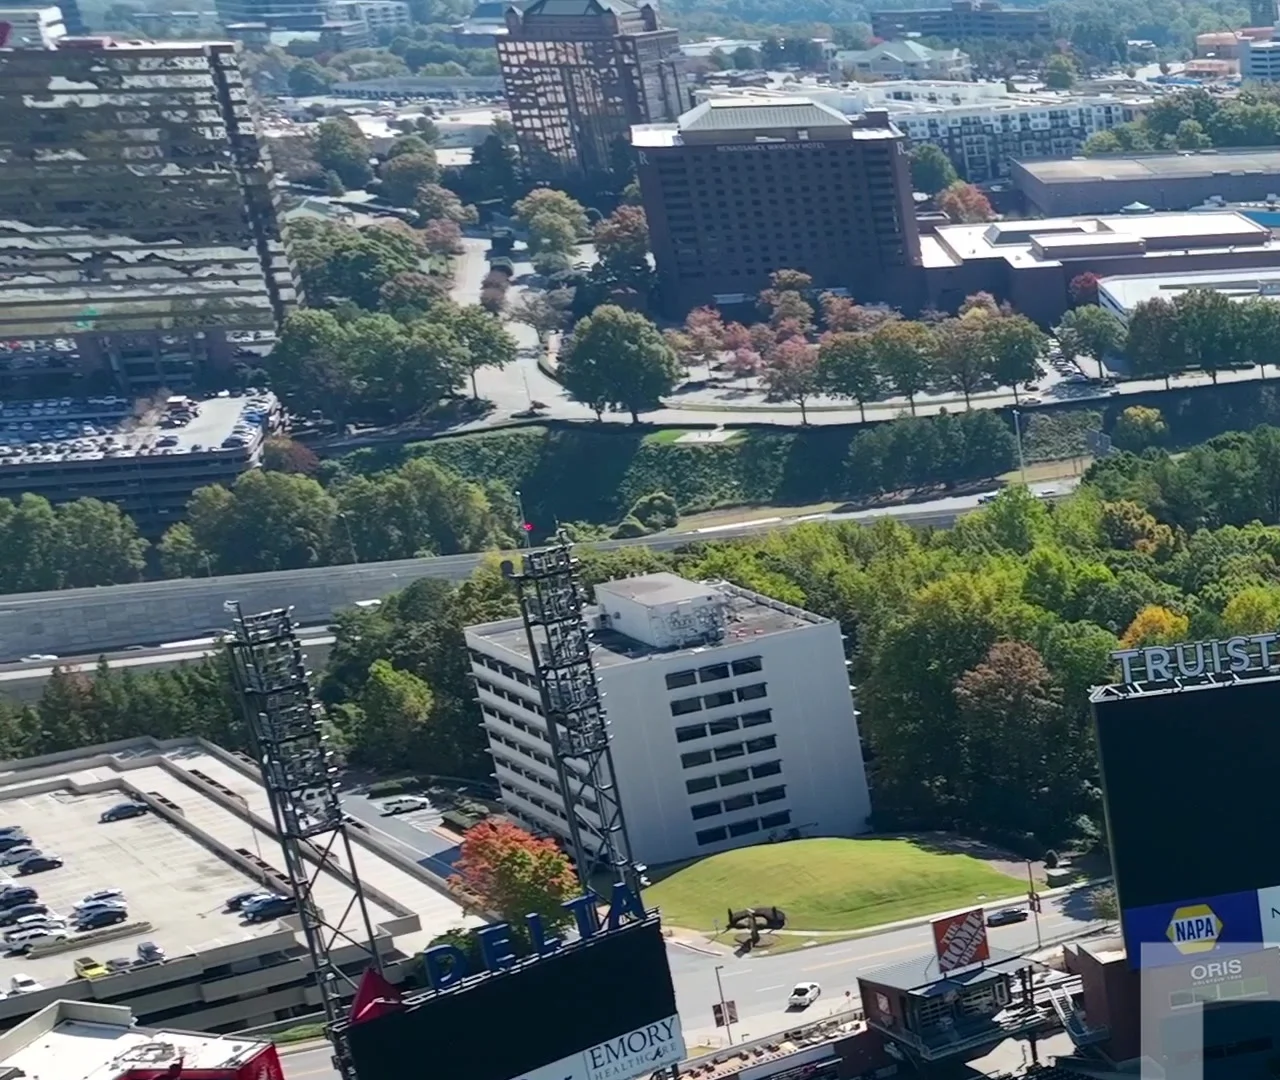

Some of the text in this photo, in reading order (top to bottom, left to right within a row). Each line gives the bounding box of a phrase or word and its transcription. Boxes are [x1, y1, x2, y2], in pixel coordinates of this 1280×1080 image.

[1112, 634, 1277, 684] TRUIST
[424, 882, 646, 991] DELTA
[940, 911, 984, 970] HOME
[1175, 918, 1216, 943] NAPA
[1191, 959, 1242, 980] ORIS
[590, 1017, 676, 1070] EMORY
